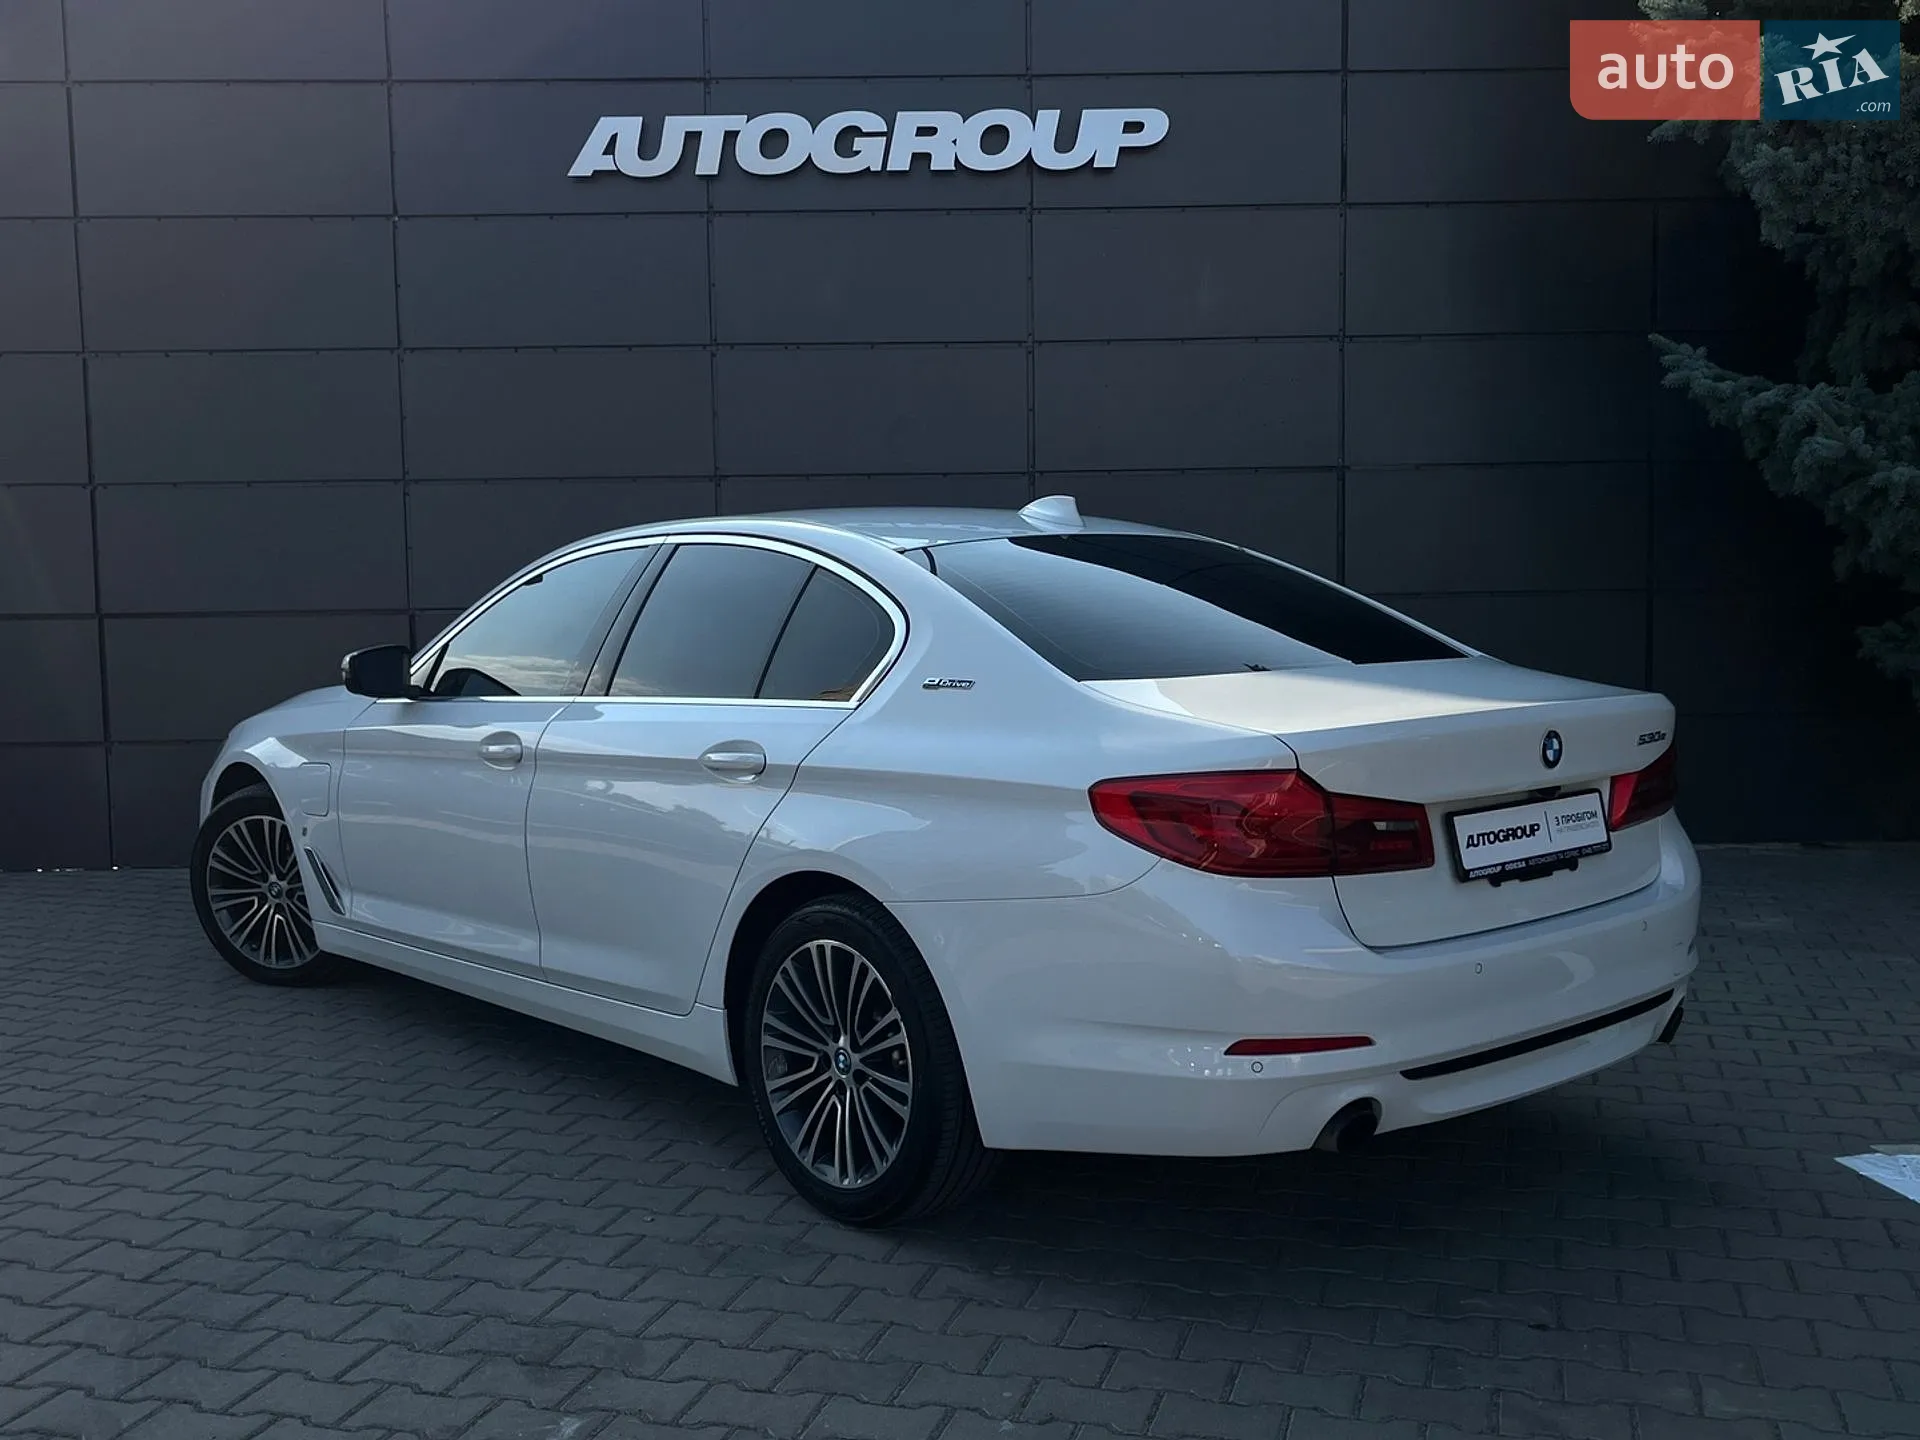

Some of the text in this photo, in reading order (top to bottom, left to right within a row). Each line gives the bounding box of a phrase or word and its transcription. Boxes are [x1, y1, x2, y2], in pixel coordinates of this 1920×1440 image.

[567, 107, 1170, 178] AUTOGROUP
[1466, 823, 1540, 849] AUTOGROUP
[1469, 861, 1526, 878] AUTOGROUP ODESA
